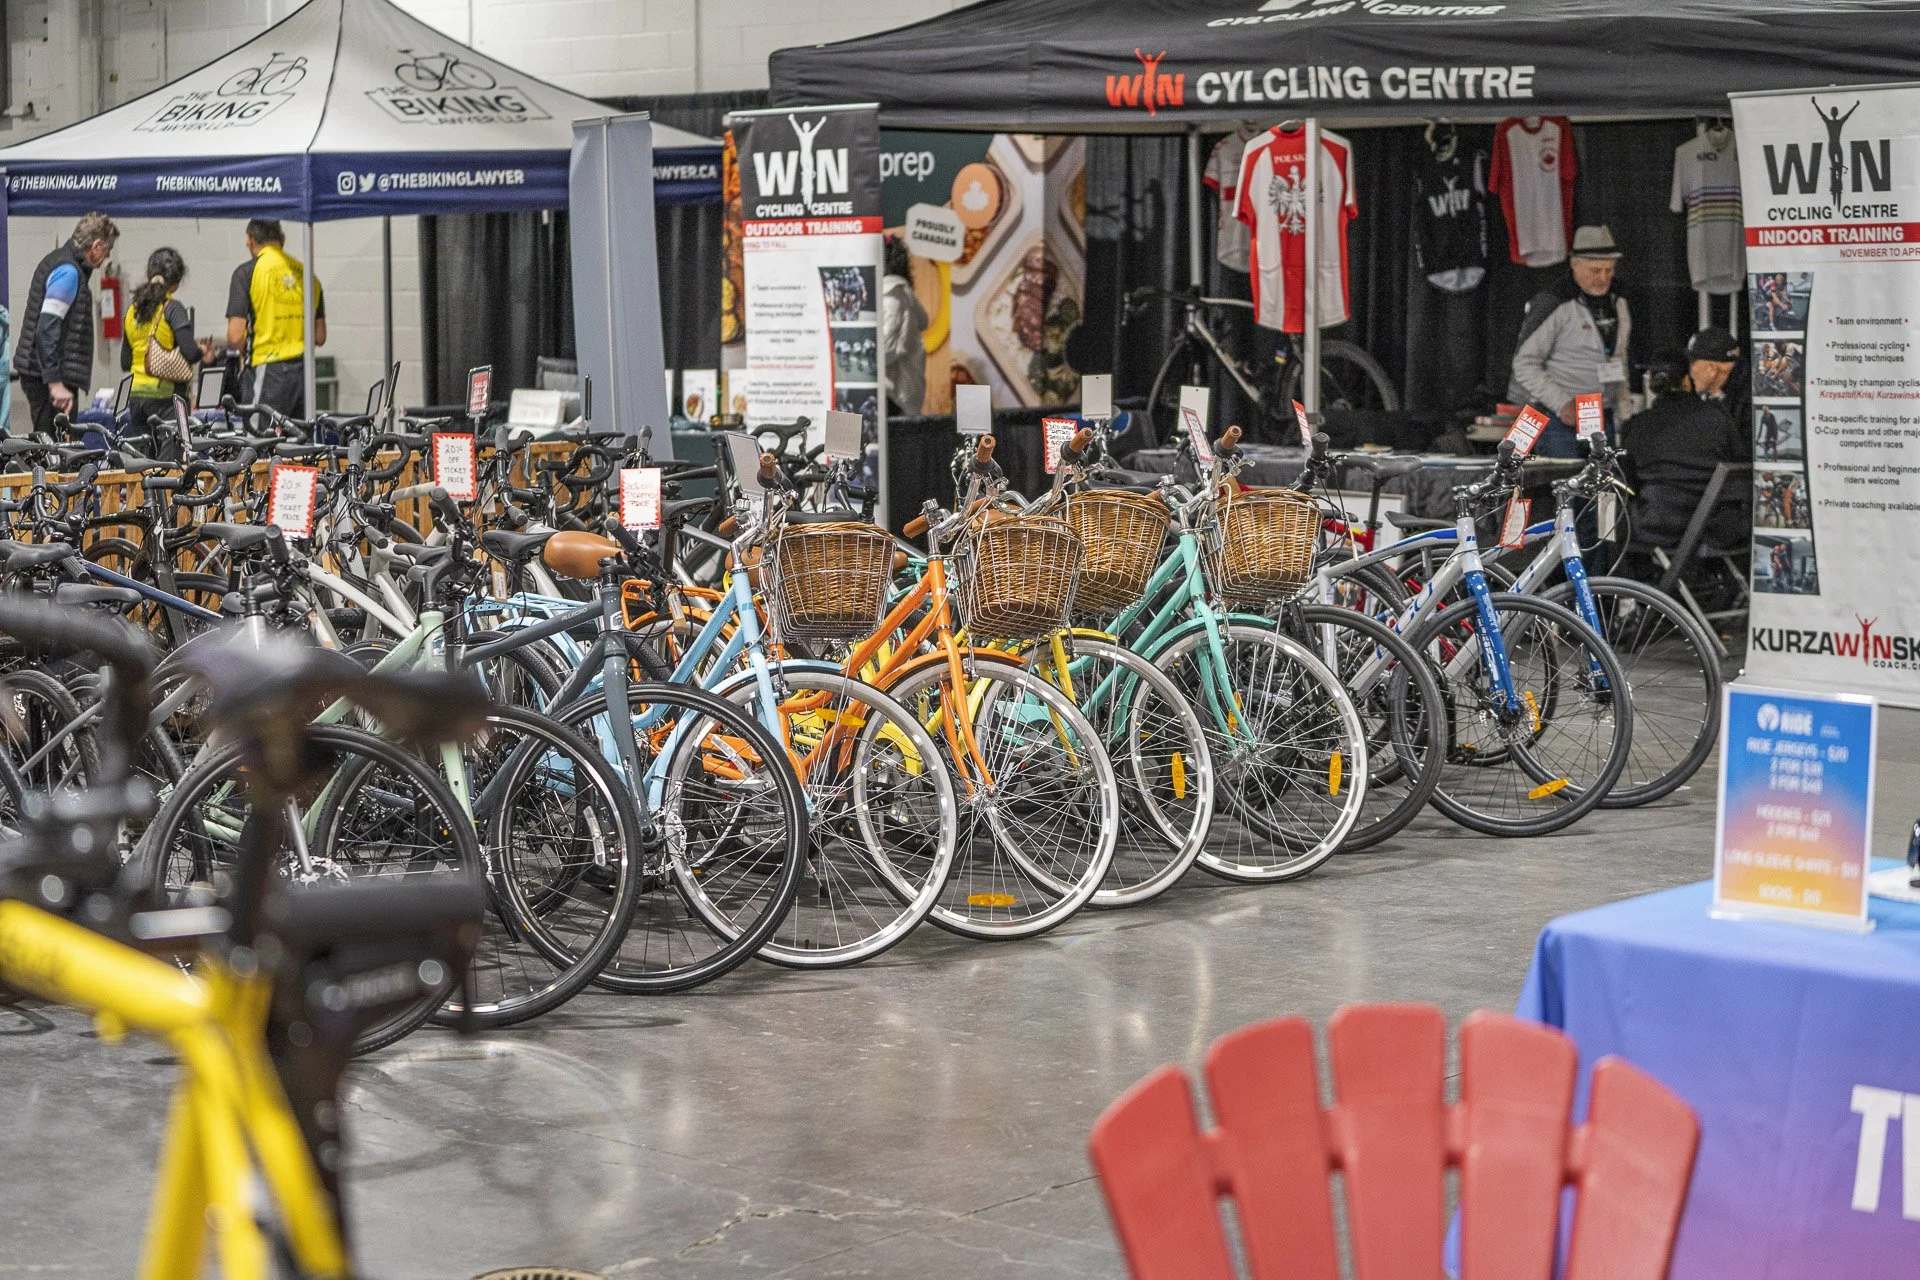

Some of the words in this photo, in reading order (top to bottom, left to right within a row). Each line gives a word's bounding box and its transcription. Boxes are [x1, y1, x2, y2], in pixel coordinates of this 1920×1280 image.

[1206, 3, 1351, 28] CYCLING
[1369, 4, 1506, 16] CENTRE
[1196, 66, 1371, 102] CYLCLING
[1380, 66, 1535, 99] CENTRE
[156, 101, 270, 123] BIKING
[390, 95, 527, 115] BIKING
[879, 151, 935, 182] prep
[11, 174, 118, 192] @THEBIKINGLAWYER
[155, 175, 282, 192] THEBIKINGLAWYER.CA
[378, 169, 524, 192] @THEBIKINGLAWYER
[756, 203, 804, 218] CYCLING
[811, 201, 853, 216] CENTRE
[1768, 206, 1832, 221] CYCLING
[1842, 203, 1899, 219] CENTRE
[745, 221, 803, 236] OUTDOOR
[806, 219, 863, 235] TRAINING
[916, 219, 955, 233] PROUDLY
[911, 230, 957, 247] CANADIAN
[1758, 228, 1825, 245] INDOOR
[1827, 226, 1905, 242] TRAINING
[1840, 247, 1888, 258] NOVEMBER
[1889, 247, 1900, 257] TO
[1902, 247, 1920, 257] APR
[1836, 316, 1854, 325] Team
[1856, 316, 1902, 325] environment
[1831, 341, 1877, 350] Professional
[1879, 341, 1905, 352] cycling
[1835, 354, 1862, 364] training
[1864, 354, 1904, 363] techniques
[1816, 377, 1847, 388] Training
[1849, 378, 1857, 388] by
[1859, 378, 1896, 388] champion
[1897, 378, 1920, 389] cyclis
[1579, 401, 1599, 409] SALE
[1521, 413, 1543, 429] SALE
[1818, 414, 1868, 424] Race-specific
[1870, 415, 1897, 425] training
[1899, 416, 1910, 424] for
[1815, 426, 1839, 436] O-Cup
[1841, 427, 1865, 435] events
[1867, 428, 1881, 436] and
[1882, 428, 1901, 436] other
[445, 444, 463, 454] 20%
[1839, 440, 1881, 449] competitive
[1883, 441, 1904, 449] races
[1823, 462, 1870, 473] Professional
[1872, 464, 1886, 473] and
[1844, 476, 1865, 485] riders
[1867, 476, 1900, 486] welcome
[283, 493, 297, 501] OFF
[1824, 499, 1850, 508] Private
[1851, 499, 1886, 511] coaching
[1888, 501, 1920, 511] available
